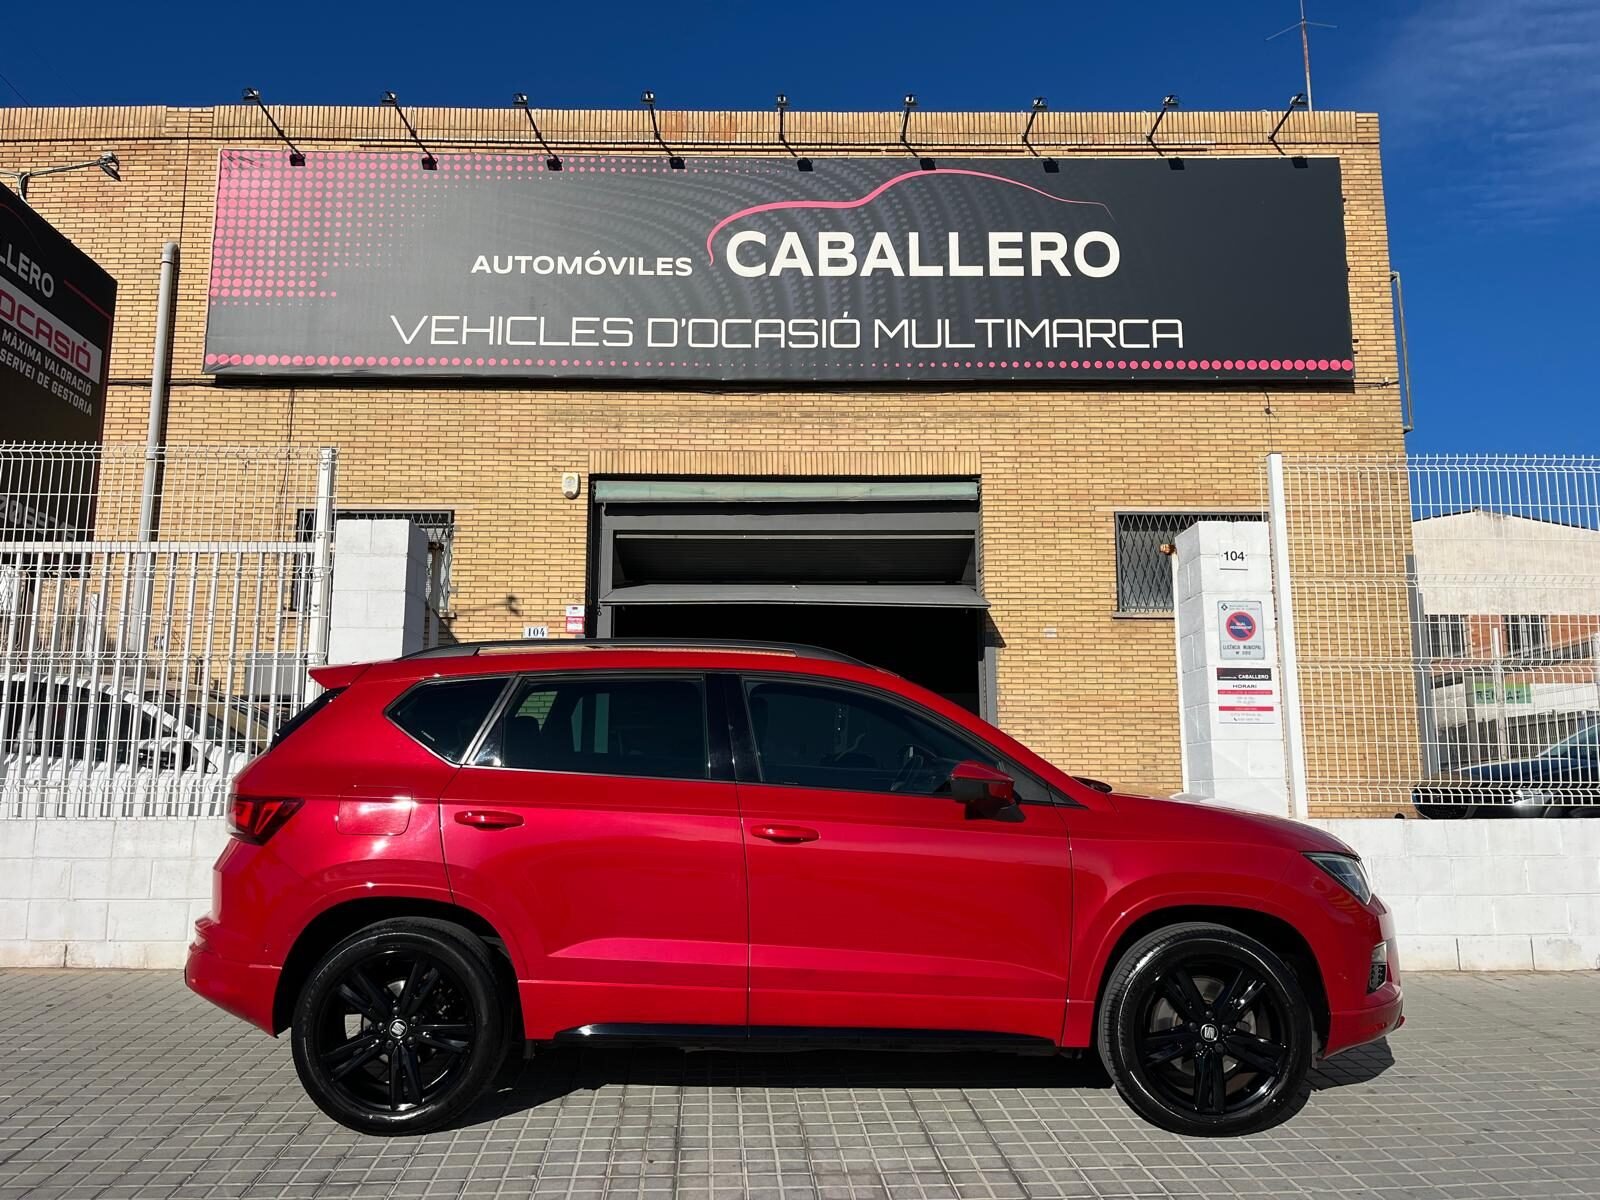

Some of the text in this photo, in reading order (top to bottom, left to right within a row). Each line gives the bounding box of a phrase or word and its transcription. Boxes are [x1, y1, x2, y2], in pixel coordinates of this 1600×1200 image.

[471, 231, 1121, 278] AUTOMÓVILES CABALLERO
[390, 312, 1184, 349] VEHICLES D'OCASIÓ MULTIMARCA
[0, 348, 92, 416] SERVEI DE GESTORIA
[2, 328, 92, 396] MÀXIMA VALORACIÓ
[527, 627, 545, 637] 104
